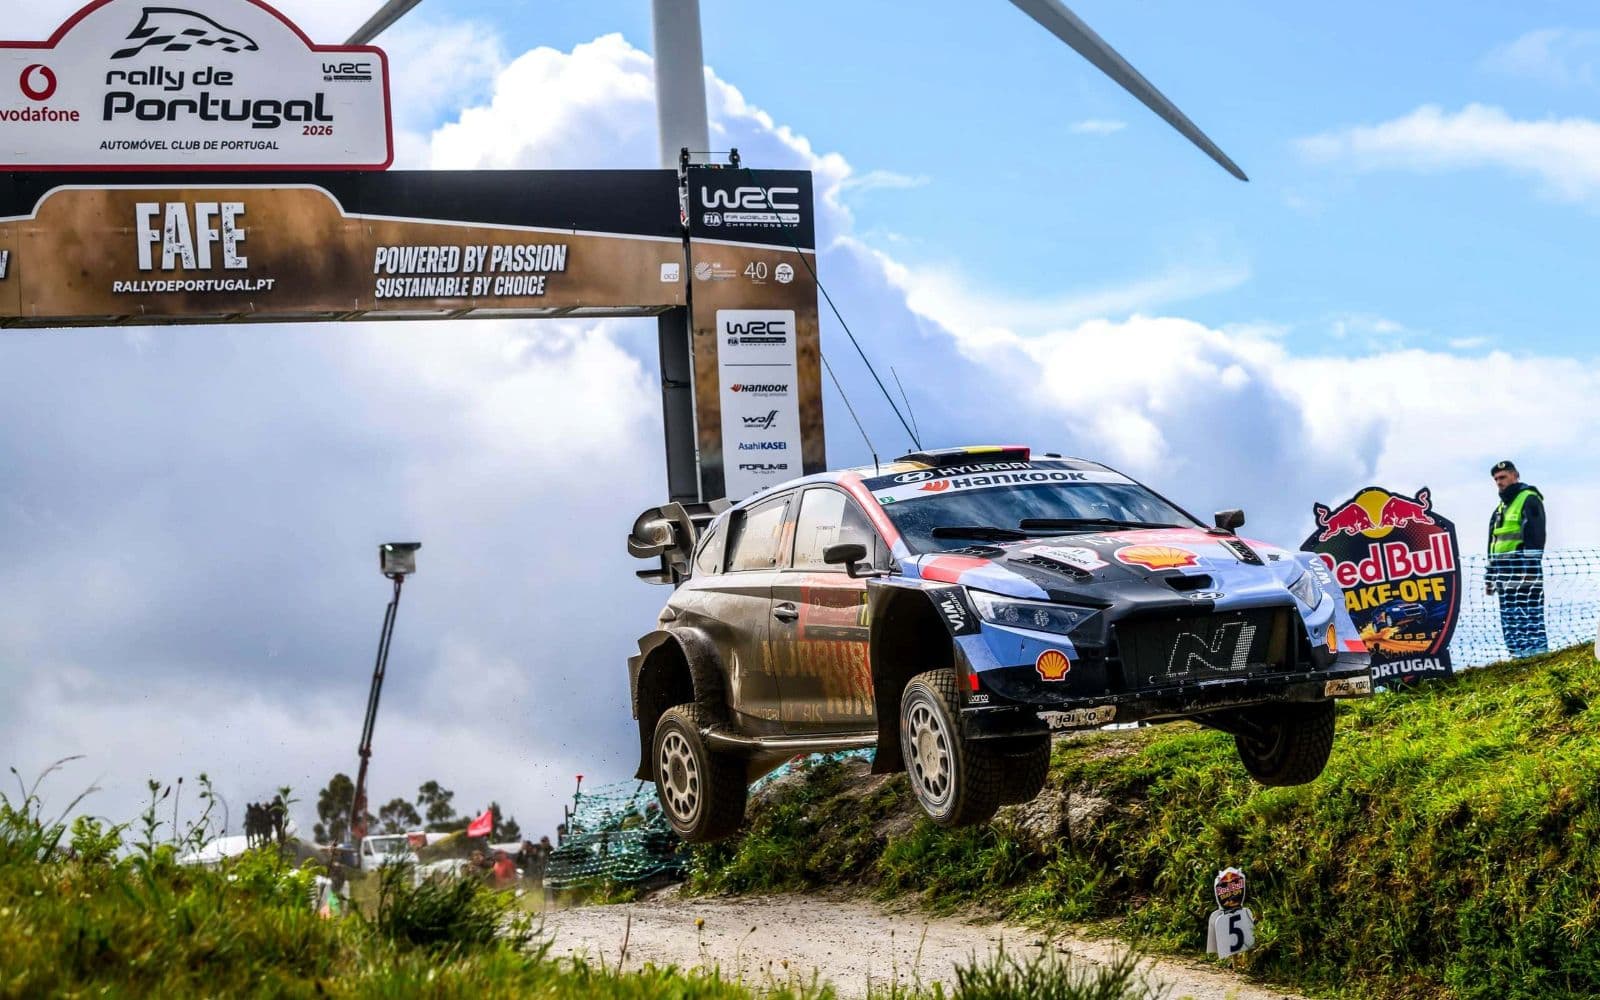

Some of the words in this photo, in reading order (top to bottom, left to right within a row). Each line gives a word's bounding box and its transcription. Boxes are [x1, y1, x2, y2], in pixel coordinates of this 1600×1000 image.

[106, 65, 185, 91] rally
[192, 66, 234, 86] de
[322, 62, 372, 74] WRC
[0, 106, 80, 122] vodafone
[102, 91, 334, 129] Portugal
[302, 125, 334, 137] 2026
[100, 138, 169, 151] AUTOMÓVEL
[170, 140, 200, 151] CLUB
[203, 140, 220, 151] DE
[221, 140, 280, 151] PORTUGAL
[701, 186, 800, 210] WRC
[135, 202, 248, 270] FAFE
[373, 246, 460, 275] POWERED
[462, 245, 490, 274] BY
[490, 244, 567, 273] PASSION
[743, 261, 768, 279] 40
[112, 278, 276, 293] RALLYDEPORTUGAL.PT
[374, 277, 469, 299] SUSTAINABLE
[471, 277, 492, 297] BY
[493, 275, 546, 296] CHOICE
[726, 321, 787, 335] WRC
[738, 440, 788, 451] AsahiKASEI
[937, 461, 1033, 476] HYUNDAI
[1383, 531, 1456, 580] Bull
[1344, 577, 1447, 612] AKE-OFF
[1371, 657, 1446, 680] ORTUGAL
[1229, 914, 1244, 952] 5
